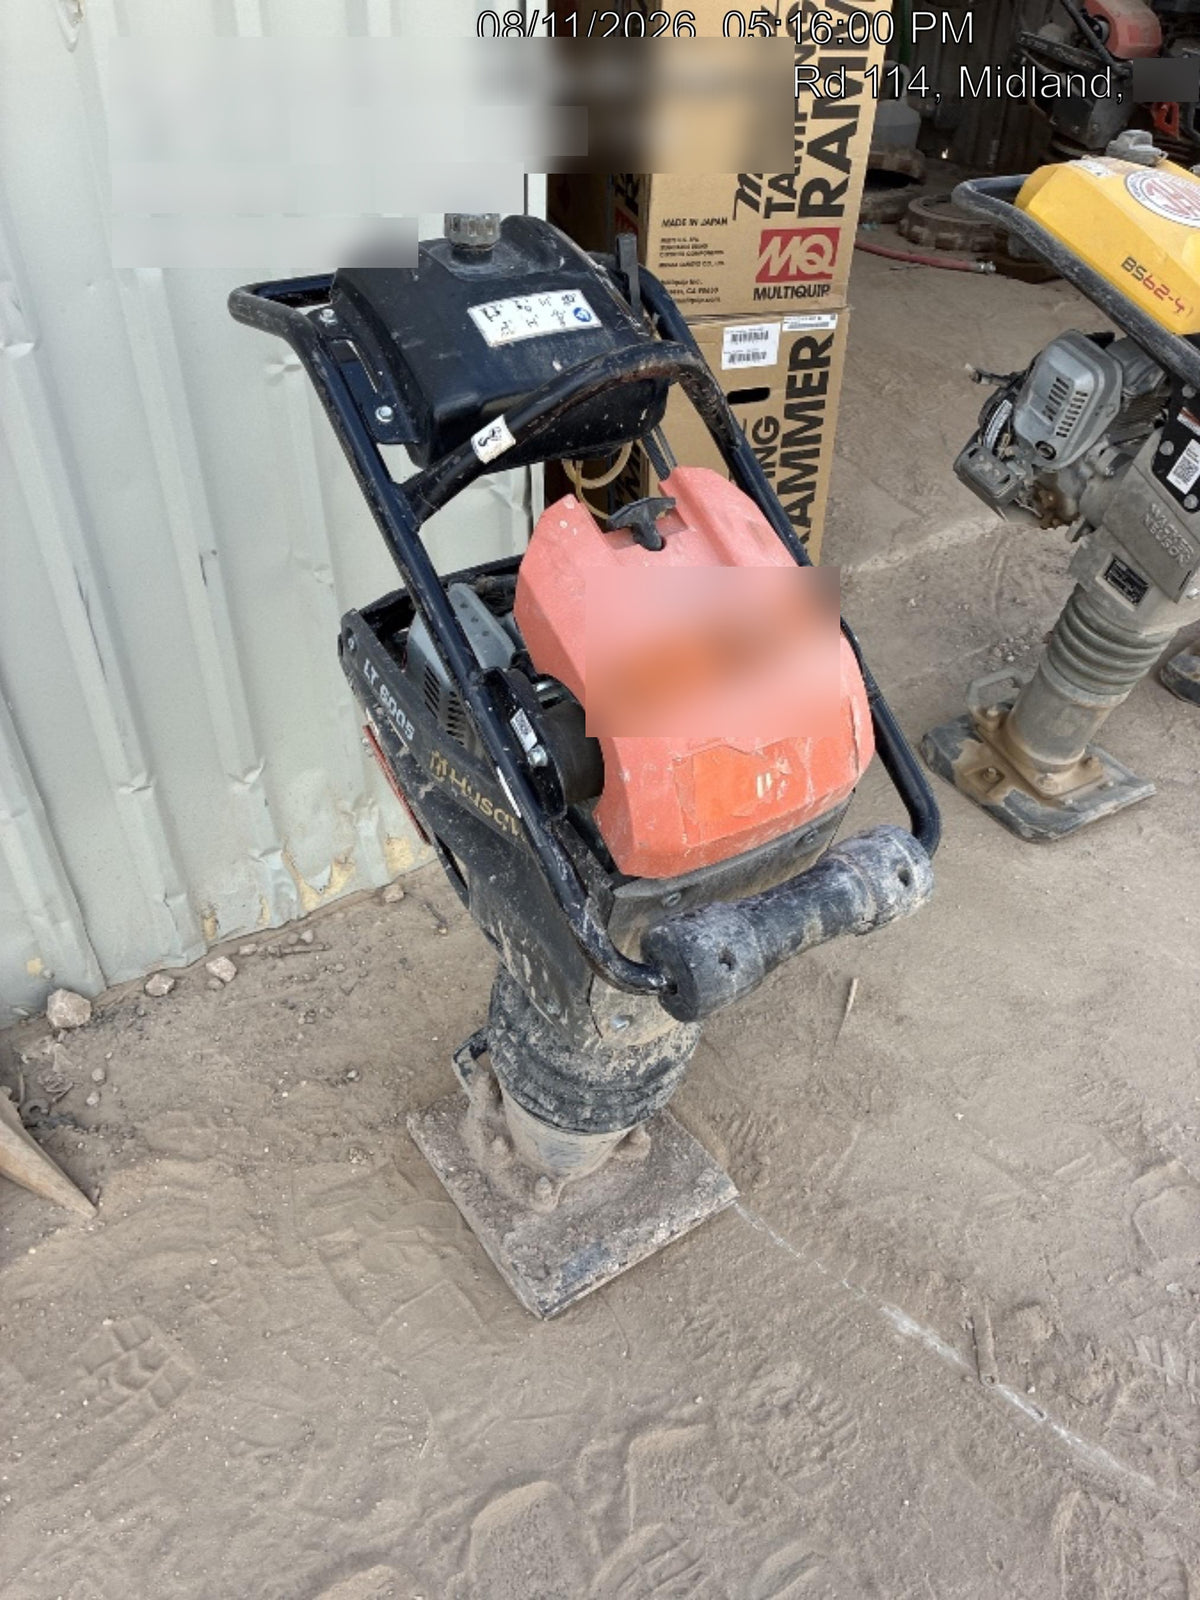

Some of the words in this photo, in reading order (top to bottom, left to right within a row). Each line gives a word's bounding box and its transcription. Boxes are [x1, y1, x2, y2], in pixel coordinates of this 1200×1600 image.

[661, 217, 687, 228] MADE
[700, 216, 728, 227] JAPAN
[755, 232, 837, 278] MQ
[753, 283, 832, 301] MULTIQUIP
[777, 332, 835, 546] AMMER
[362, 658, 380, 686] LT
